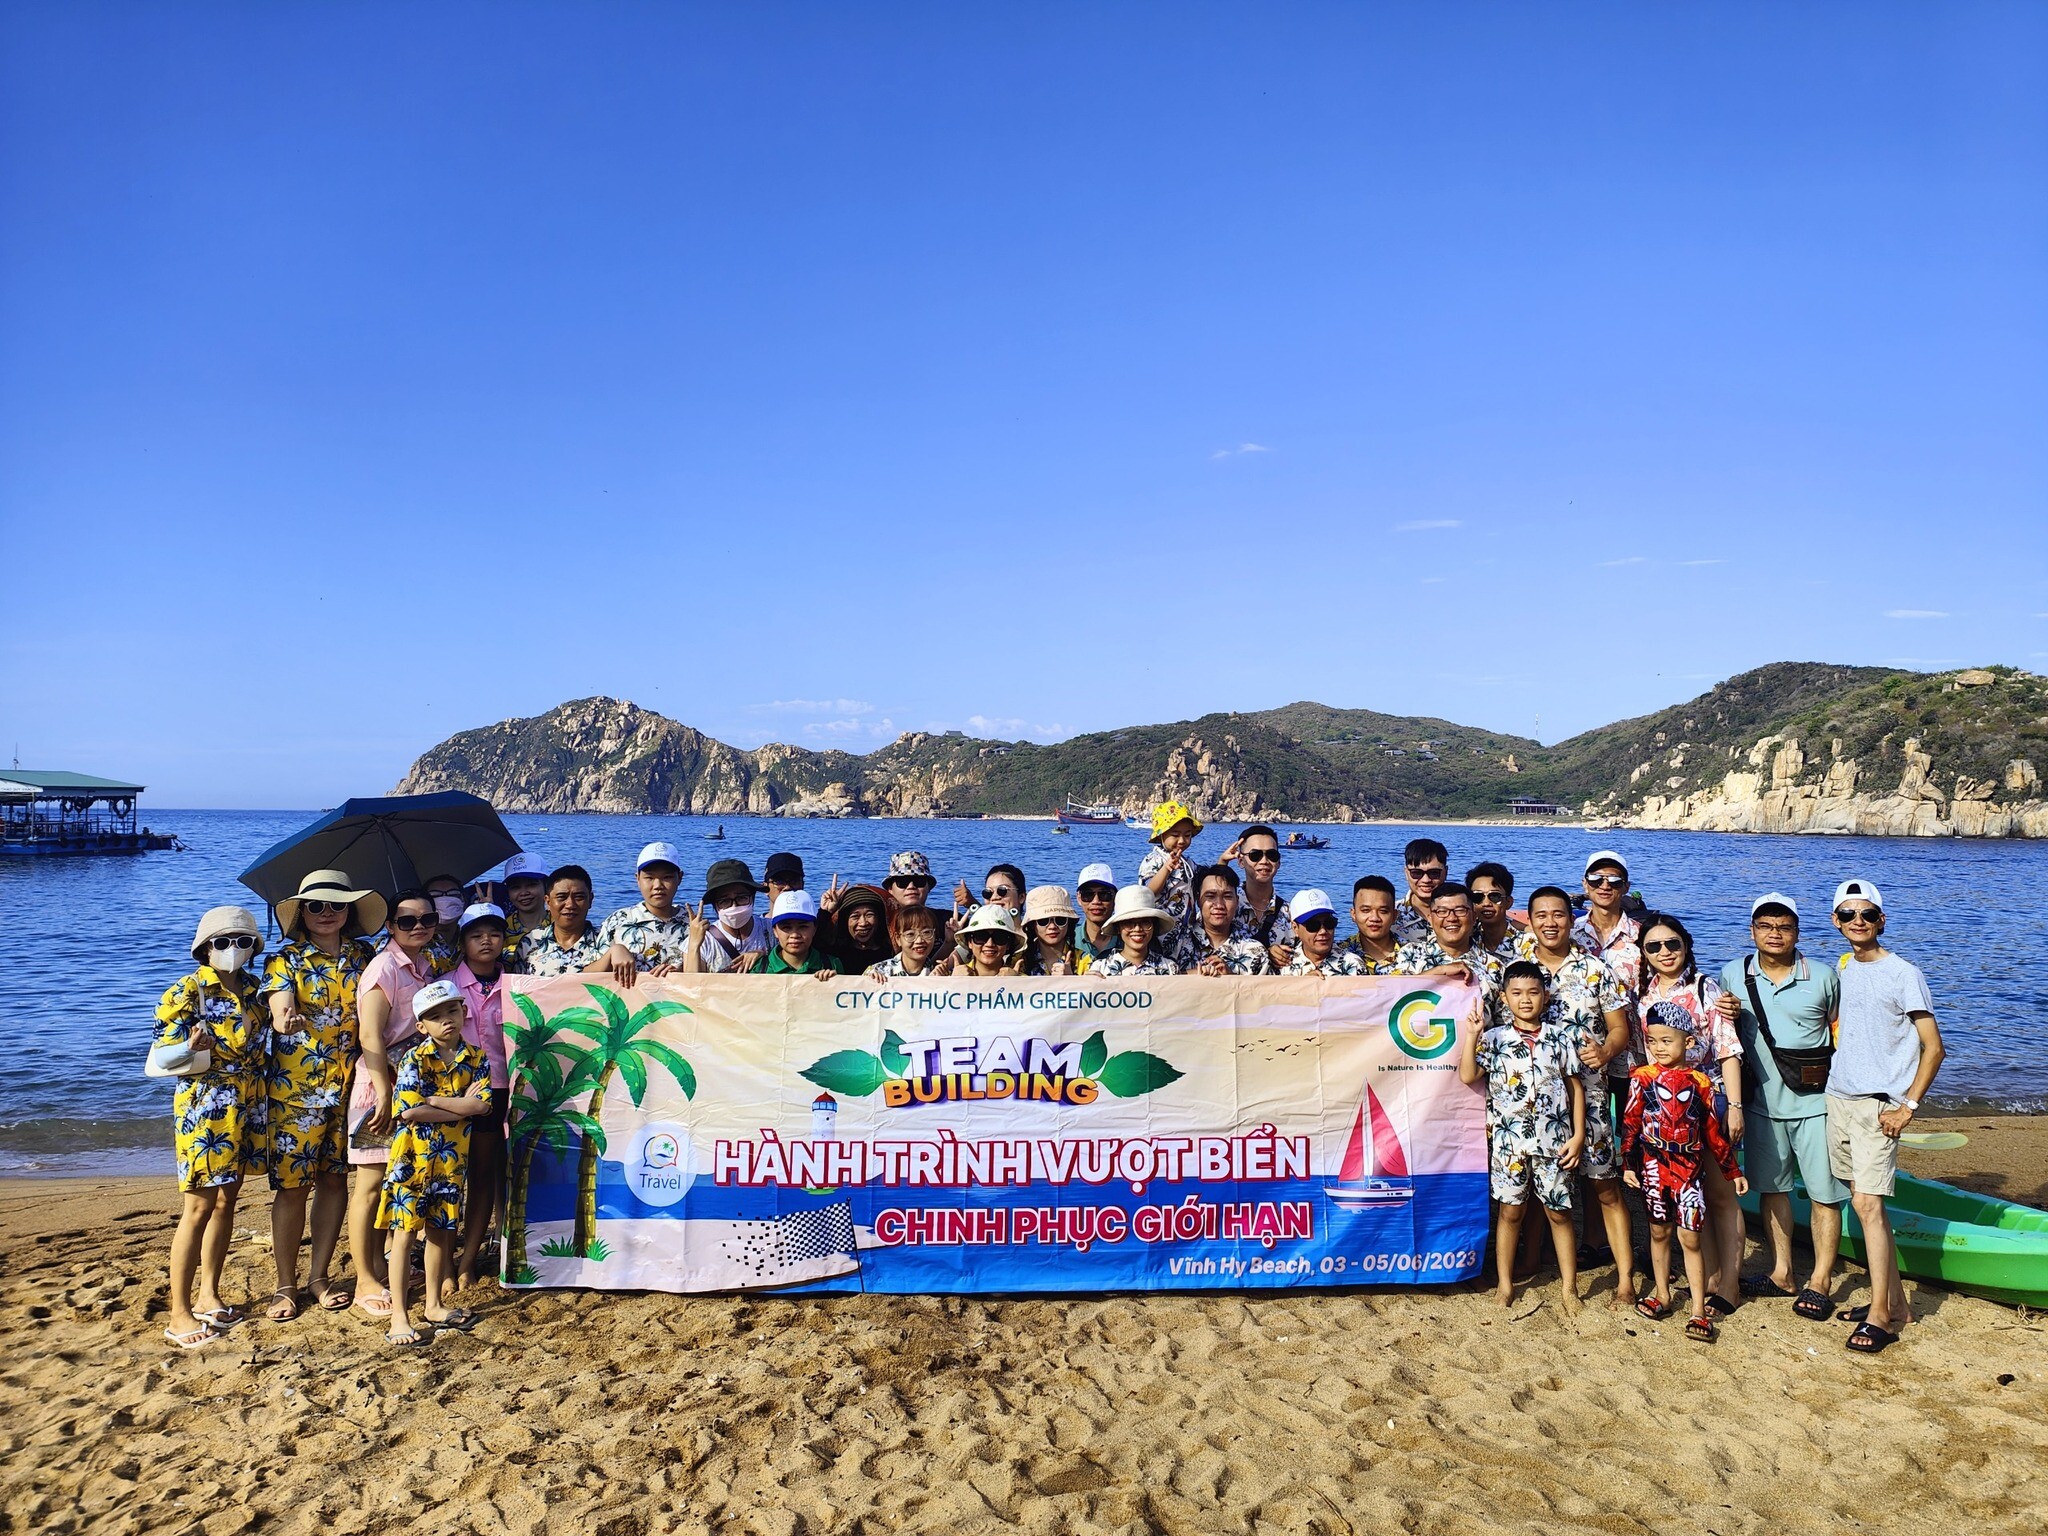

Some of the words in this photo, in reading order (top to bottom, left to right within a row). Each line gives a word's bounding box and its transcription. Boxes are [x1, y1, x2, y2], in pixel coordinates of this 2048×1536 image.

[835, 991, 874, 1009] CTY
[878, 991, 903, 1009] CP
[906, 990, 961, 1014] THỰC
[966, 987, 1024, 1010] PHẨM
[1029, 991, 1153, 1009] GREENGOOD
[898, 1036, 1083, 1079] TEAM
[1387, 1064, 1414, 1072] Nature
[1426, 1064, 1458, 1072] Healthy
[882, 1072, 1099, 1108] BUILDING
[714, 1128, 867, 1187] HÀNH
[873, 1128, 1031, 1187] TRÌNH
[1037, 1137, 1193, 1196] VƯỢT
[1198, 1122, 1311, 1181] BIỂN
[639, 1173, 681, 1190] Travel
[874, 1206, 1009, 1246] CHINH
[1011, 1205, 1129, 1254] PHỤC
[1132, 1194, 1219, 1243] GIỚI
[1222, 1201, 1314, 1250] HẠN
[1168, 1255, 1216, 1275] Vĩnh
[1219, 1257, 1247, 1278] Hy
[1250, 1256, 1316, 1277] Beach,
[1319, 1256, 1348, 1274] 03
[1362, 1250, 1477, 1273] 05/06/2023
